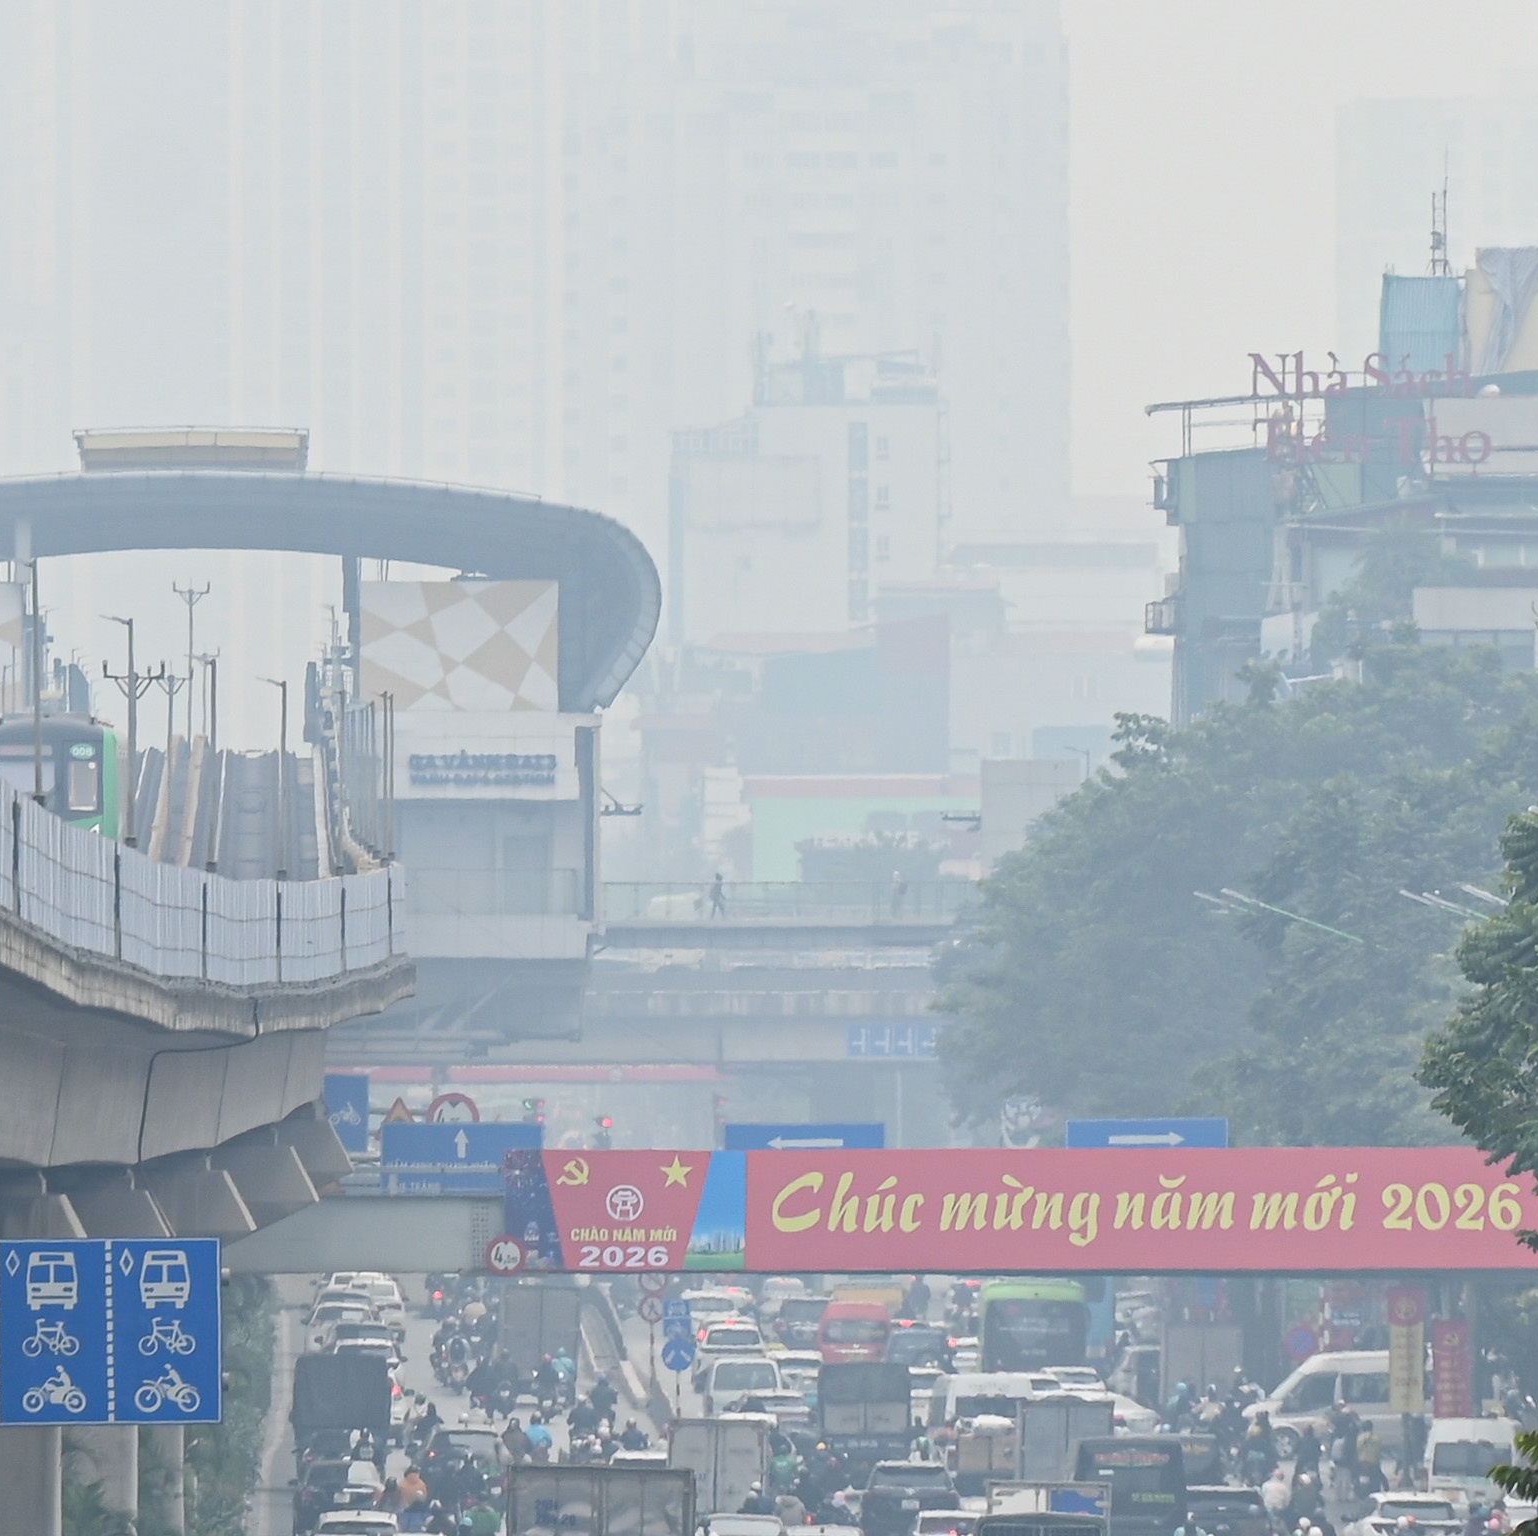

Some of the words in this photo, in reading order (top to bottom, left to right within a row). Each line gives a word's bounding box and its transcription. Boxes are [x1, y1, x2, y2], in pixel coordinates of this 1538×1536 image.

[1248, 350, 1348, 399] Nhà
[1363, 351, 1475, 399] Sách
[1383, 415, 1493, 477] Thọ
[570, 1225, 609, 1242] CHÀO
[613, 1225, 646, 1242] NĂM
[650, 1224, 678, 1242] MỚI
[773, 1172, 925, 1233] Chúc
[939, 1174, 1100, 1247] mừng
[1114, 1174, 1236, 1231] năm
[1250, 1172, 1359, 1231] mới
[1382, 1182, 1523, 1231] 2026
[579, 1245, 669, 1267] 2026
